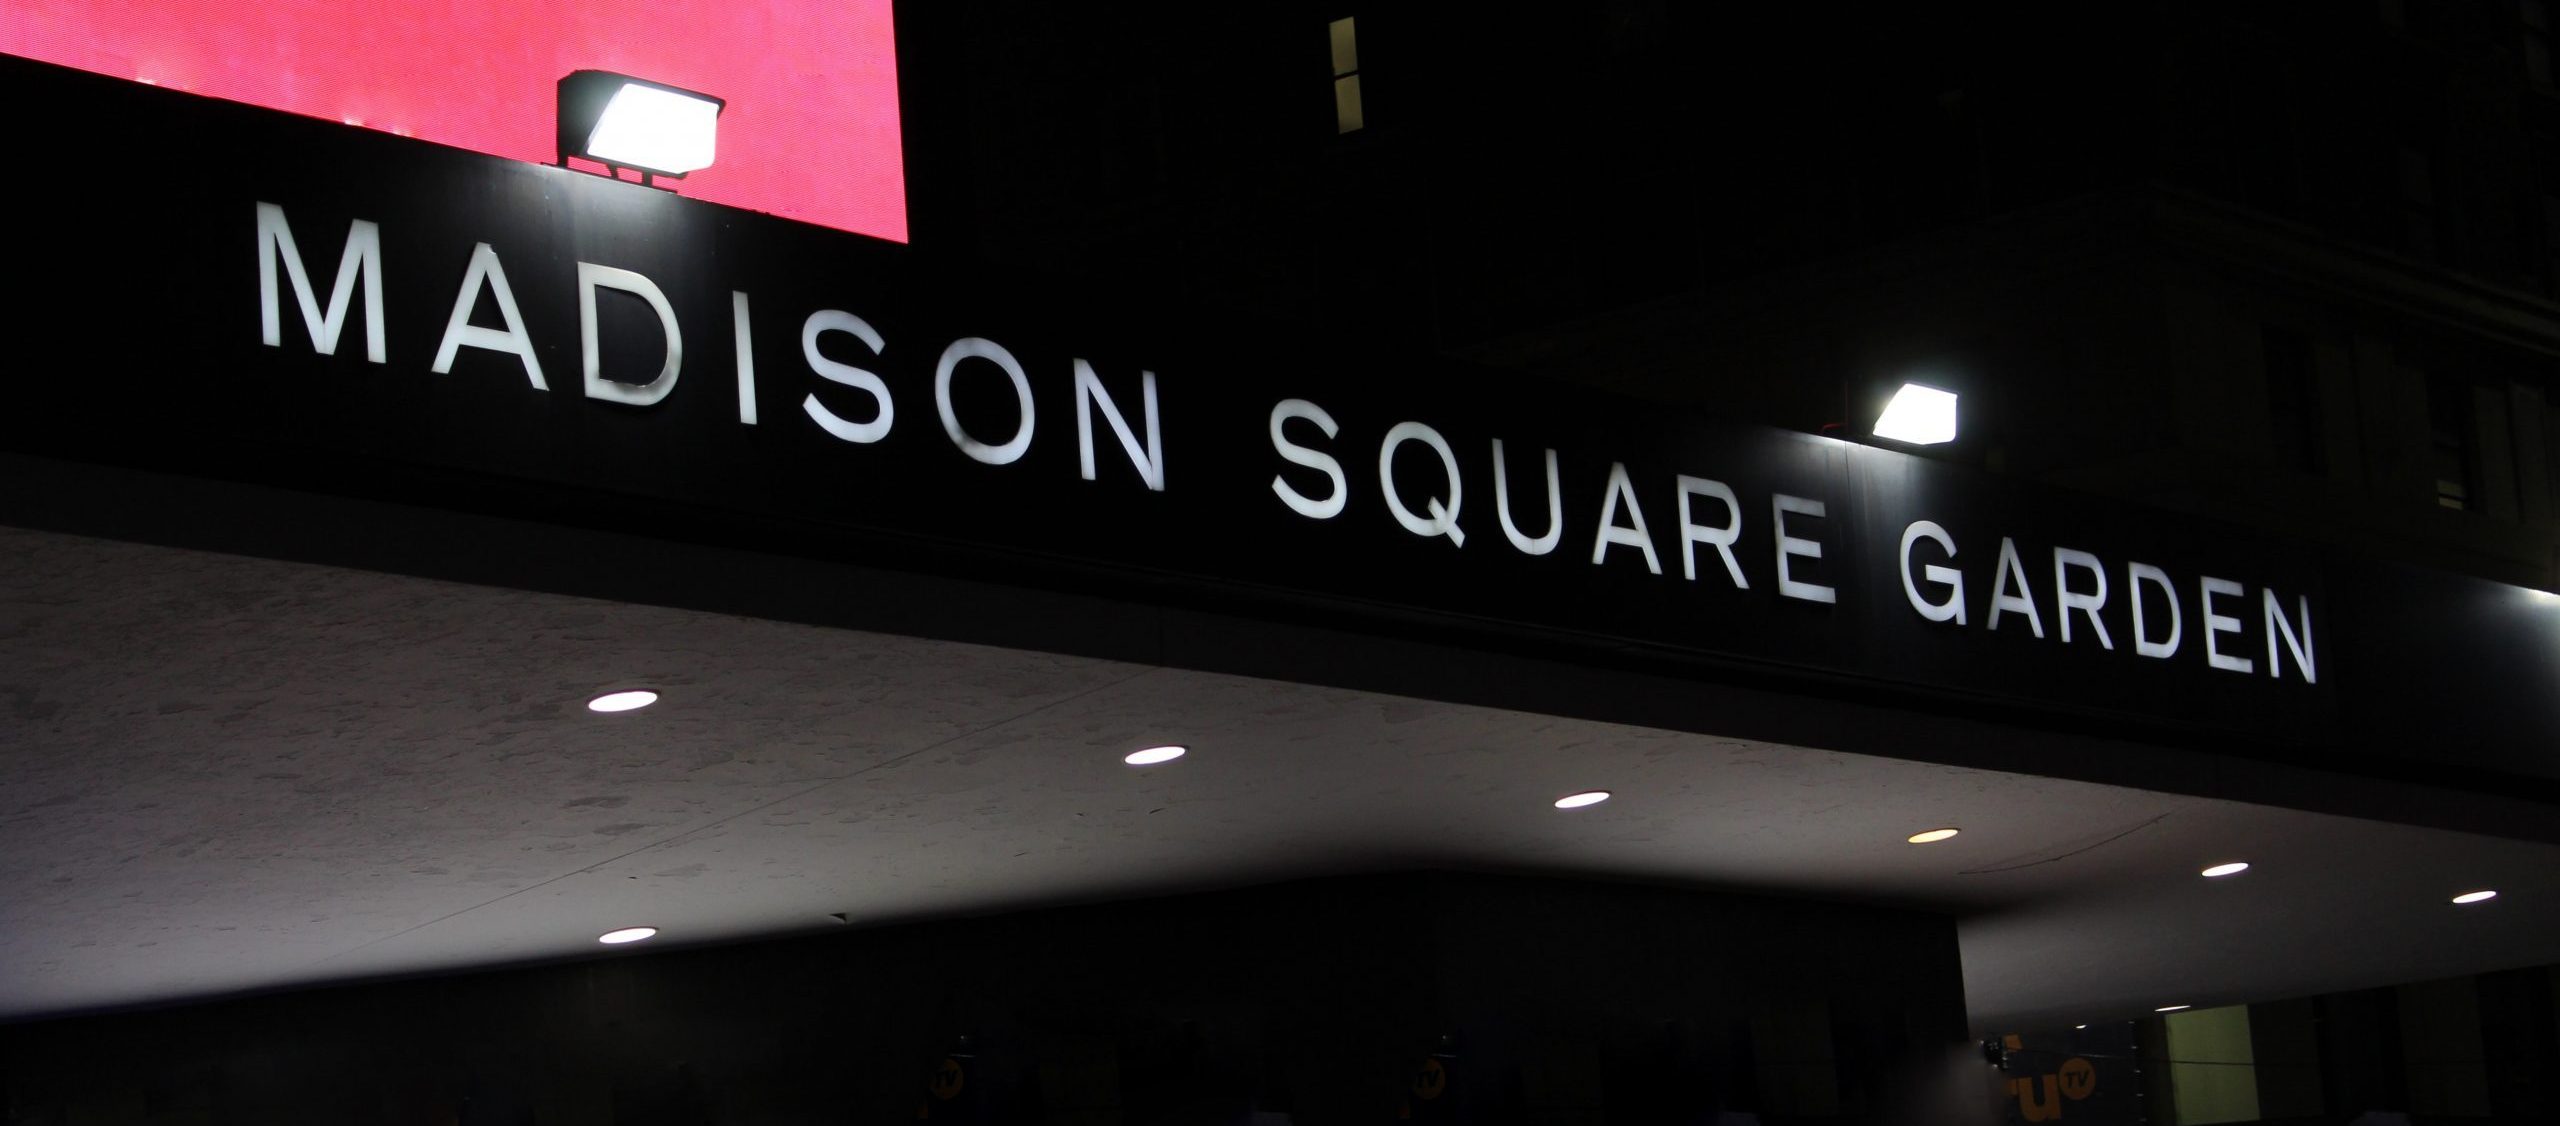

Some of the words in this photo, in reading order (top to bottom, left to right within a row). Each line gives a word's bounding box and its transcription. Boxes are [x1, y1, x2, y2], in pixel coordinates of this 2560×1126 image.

[256, 203, 1165, 492] MADISON
[1269, 398, 1838, 607] SQUARE
[1898, 519, 2318, 685] GARDEN
[2063, 1069, 2090, 1089] TV
